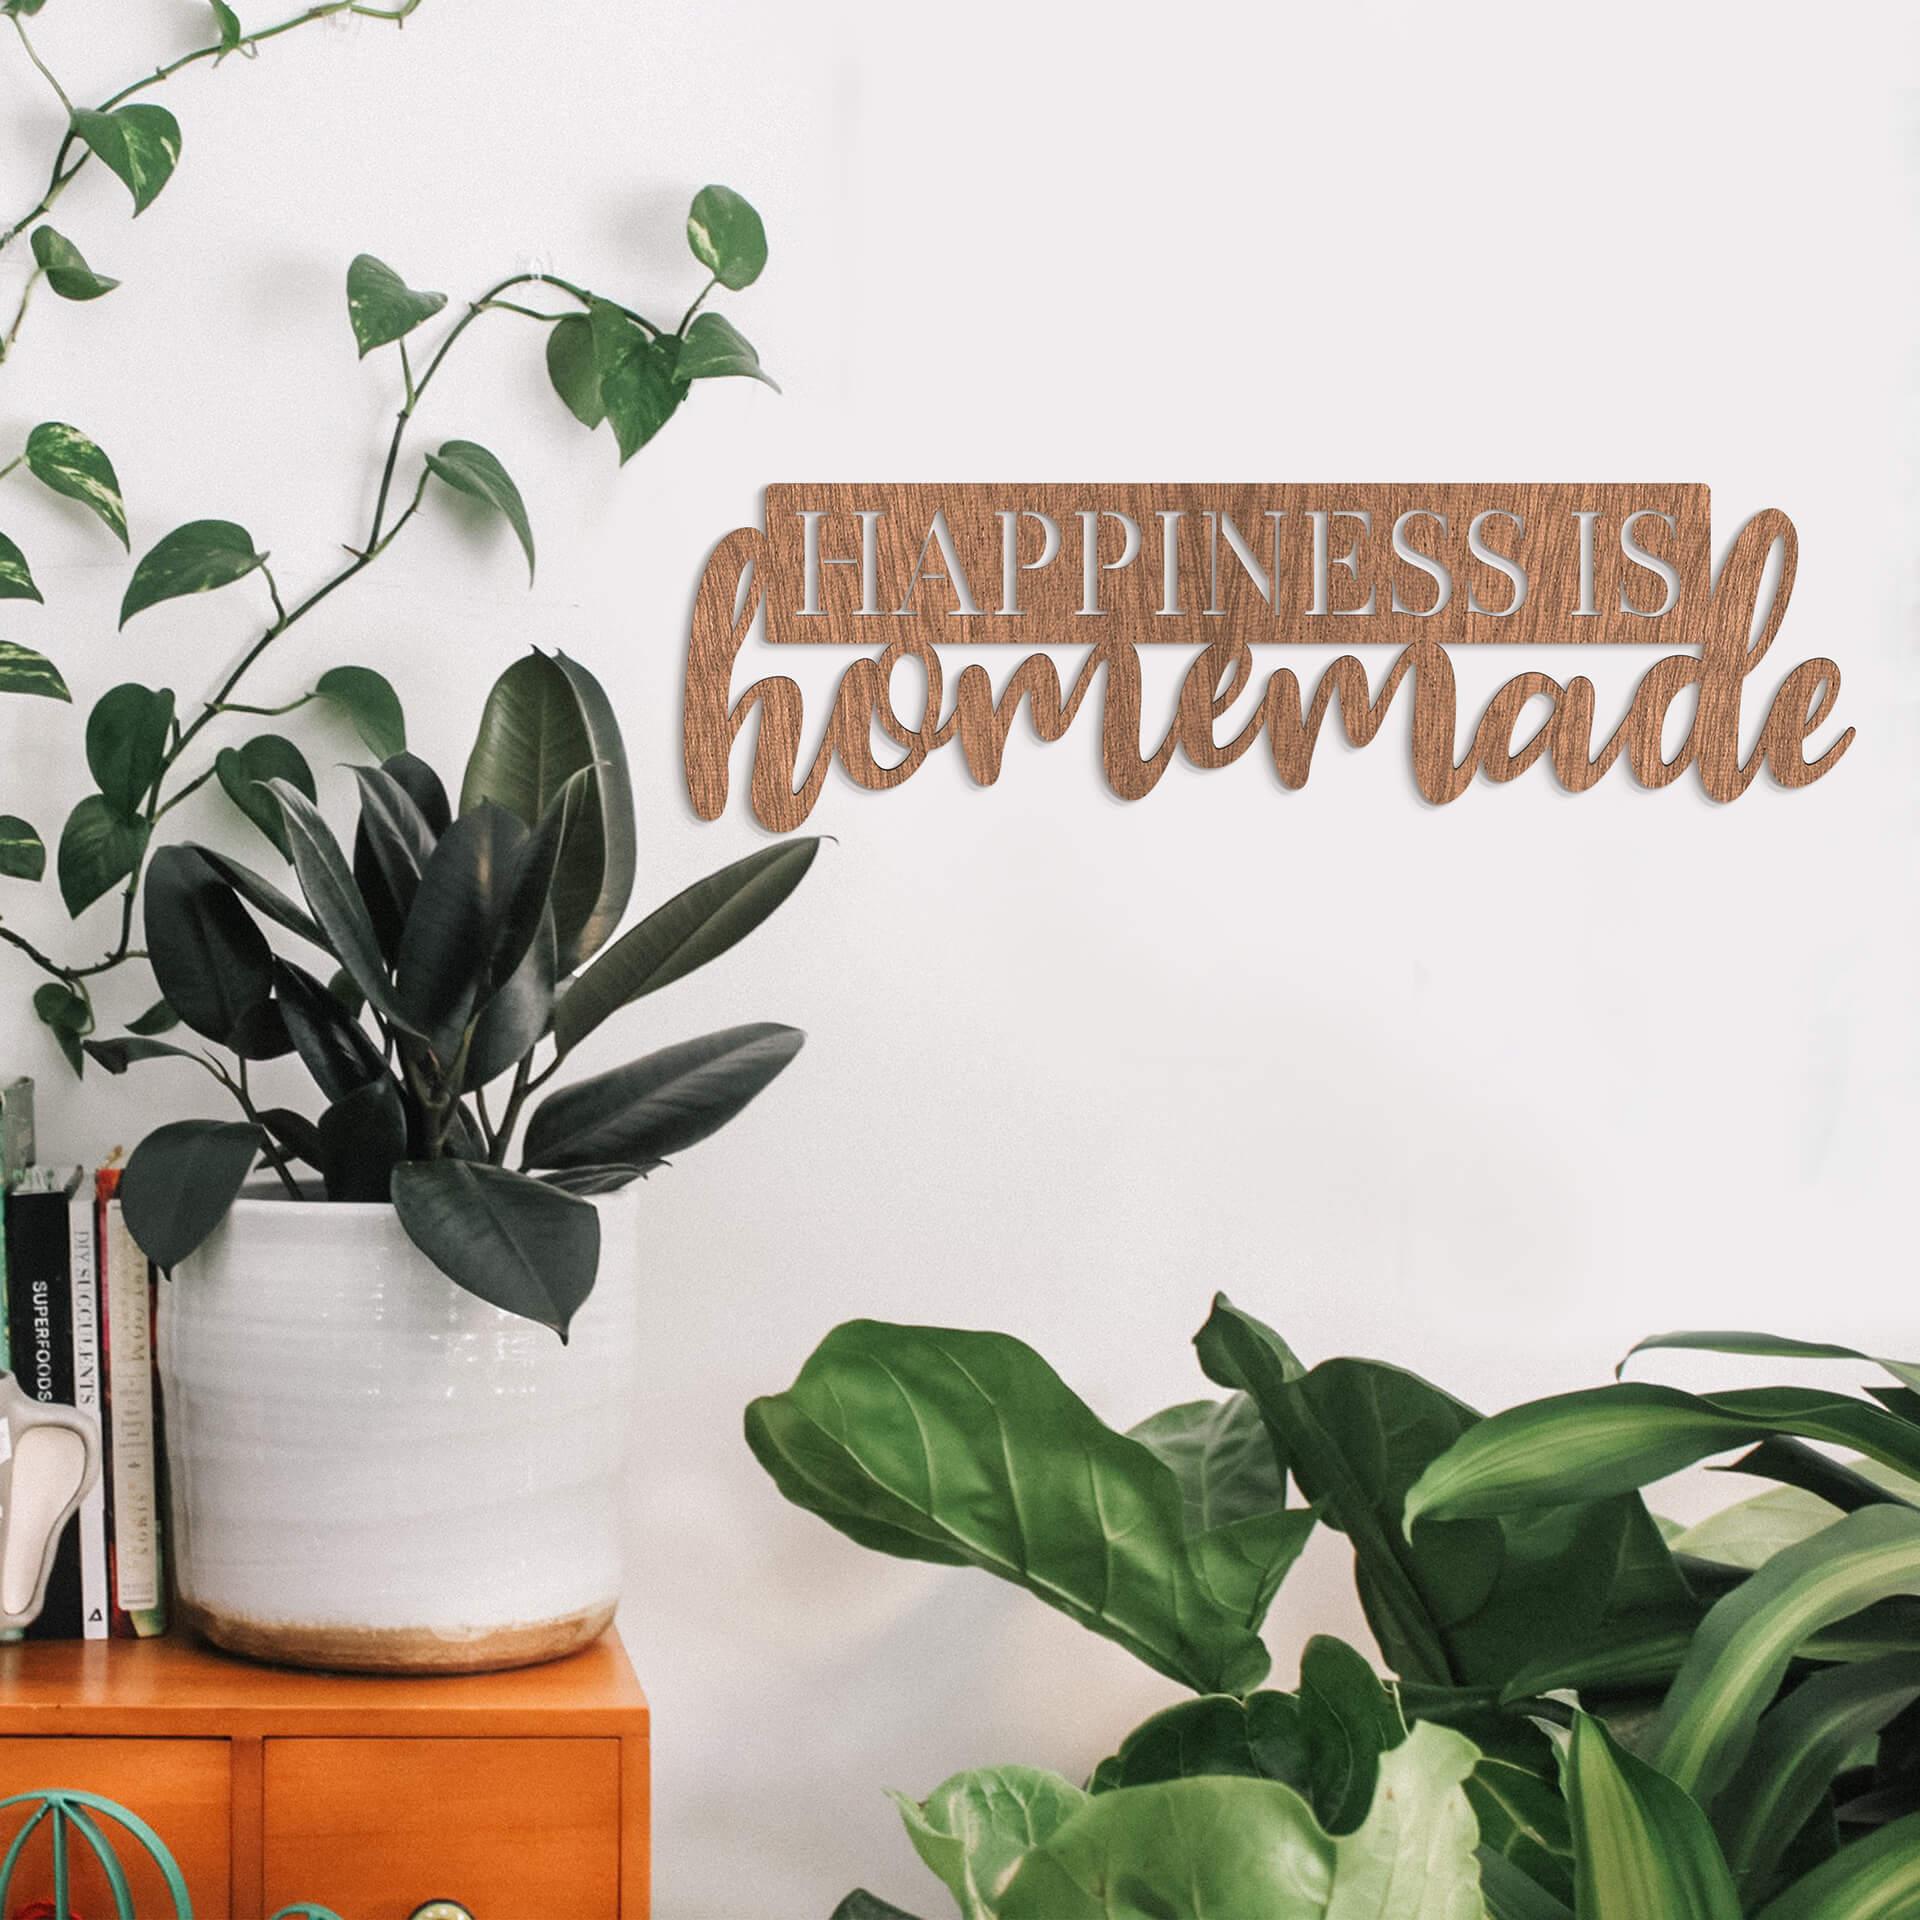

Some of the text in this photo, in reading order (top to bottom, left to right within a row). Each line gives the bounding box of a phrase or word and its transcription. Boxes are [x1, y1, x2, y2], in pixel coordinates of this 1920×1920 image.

[794, 508, 1681, 618] HAPPINESS IS
[683, 508, 1856, 833] homemade
[32, 1281, 53, 1402] SUPERFOODS
[74, 1231, 95, 1404] DIY SUCCULENTS
